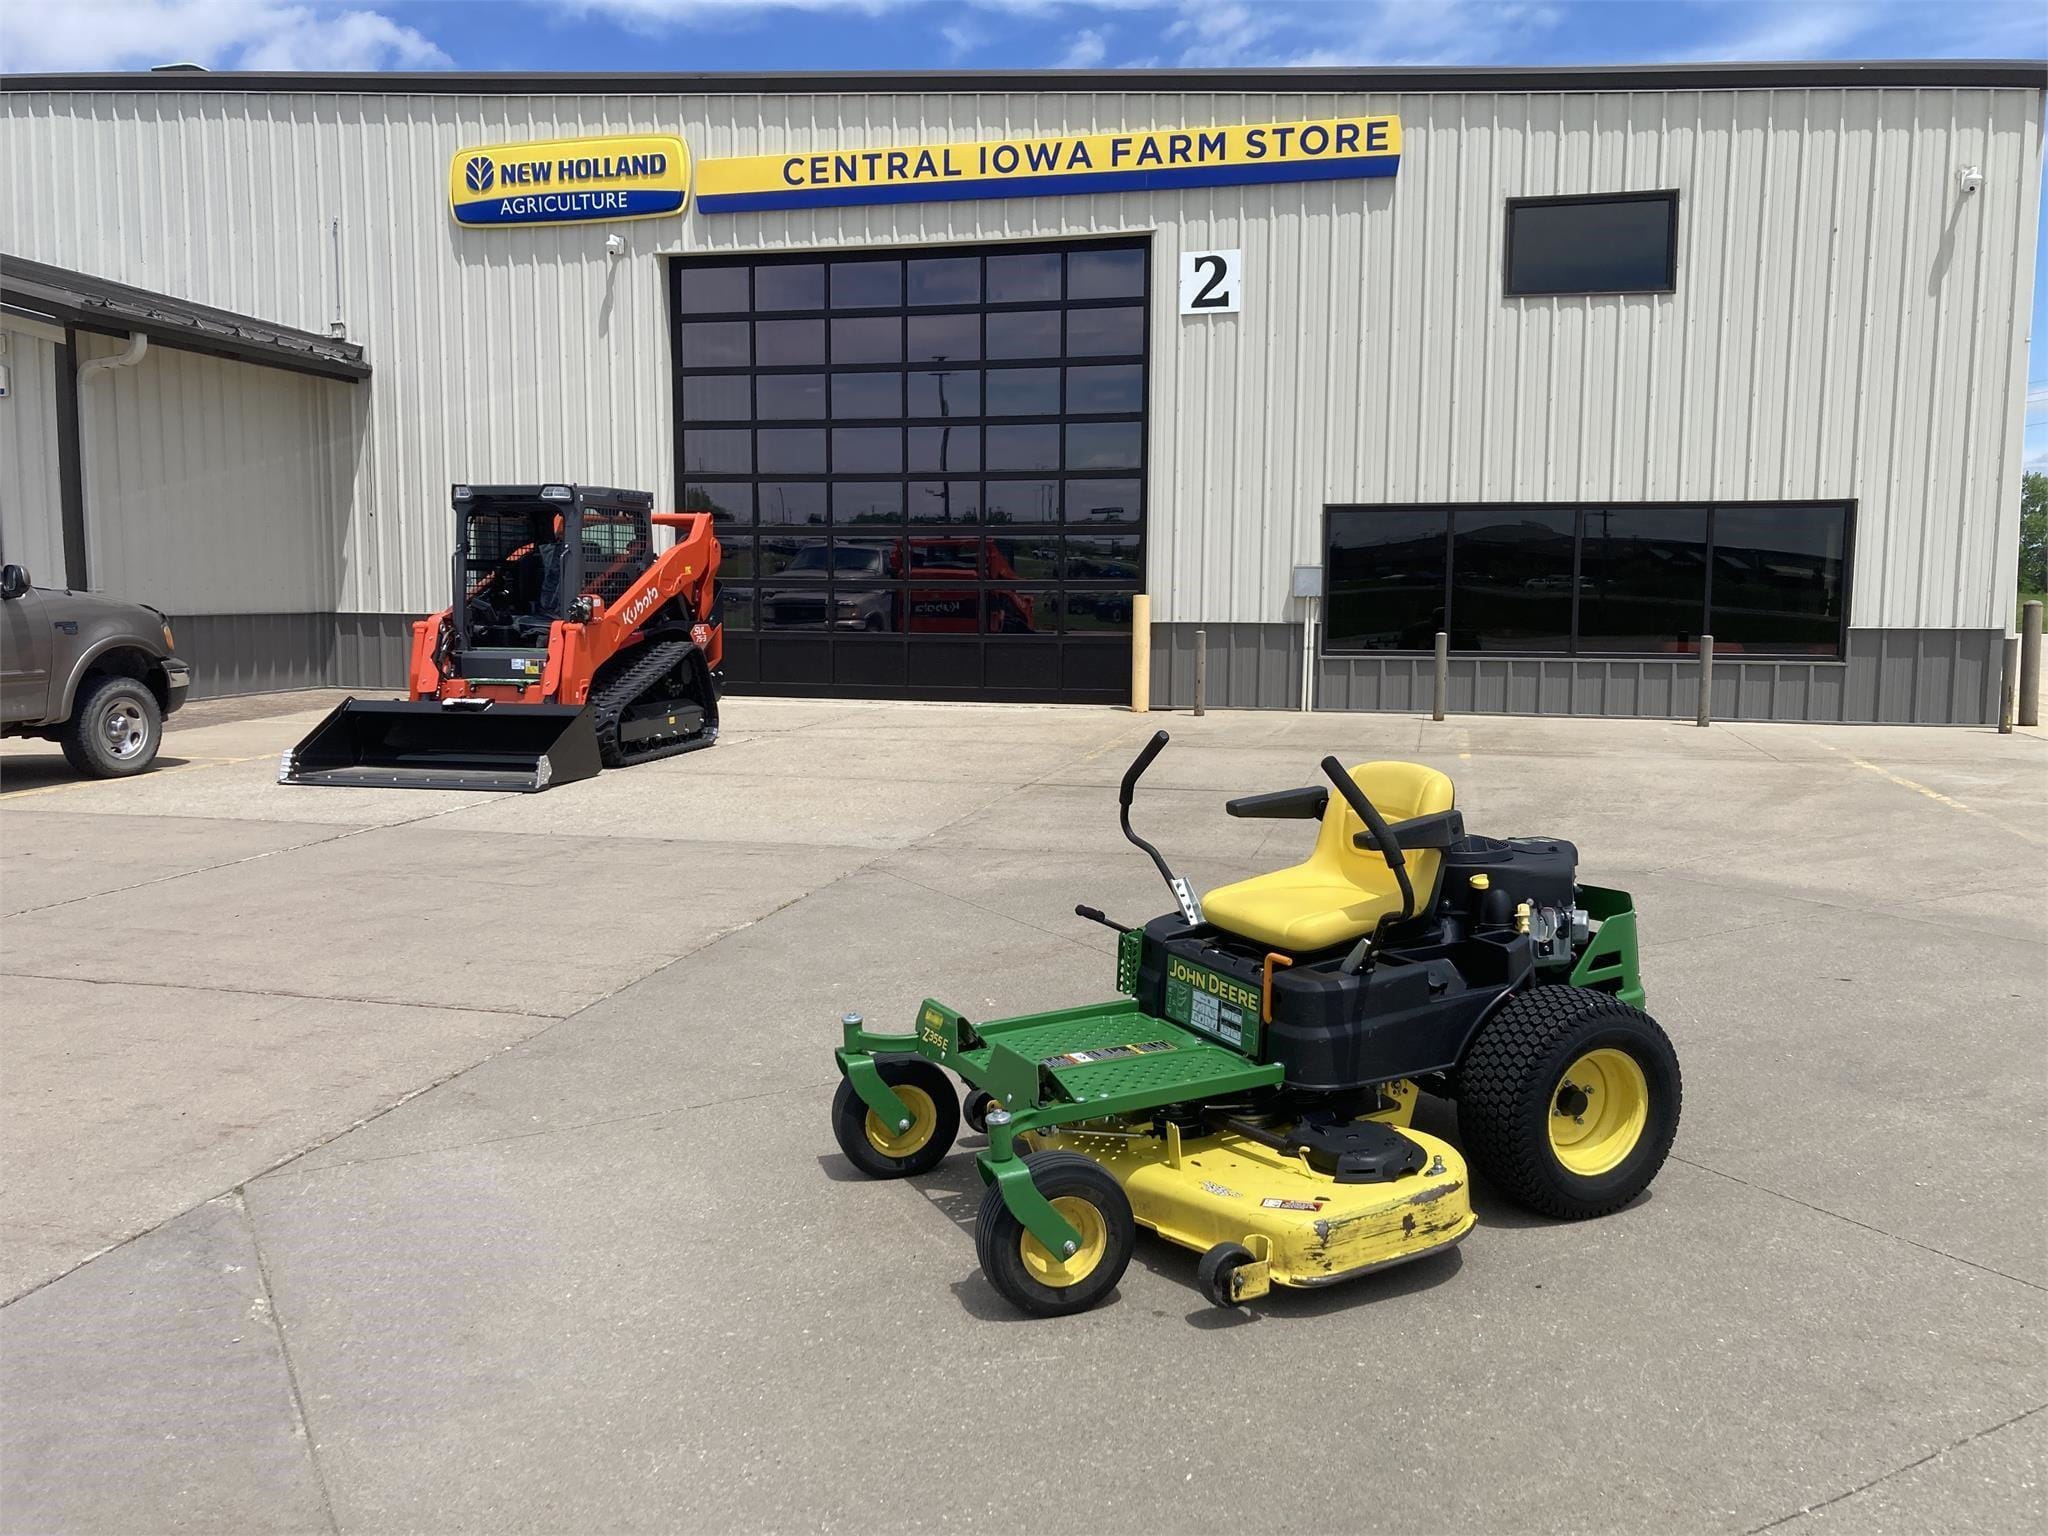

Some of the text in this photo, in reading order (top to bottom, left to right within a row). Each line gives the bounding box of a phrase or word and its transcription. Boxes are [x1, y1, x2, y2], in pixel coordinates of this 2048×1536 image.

[500, 153, 667, 185] NEW HOLLAND
[783, 121, 1390, 186] CENTRAL IOWA FARM STORE
[500, 192, 628, 216] AGRICULTURE
[1191, 254, 1230, 309] 2
[622, 586, 659, 625] Kubota
[1169, 959, 1206, 989] JOHN
[1208, 973, 1259, 1012] DEERE
